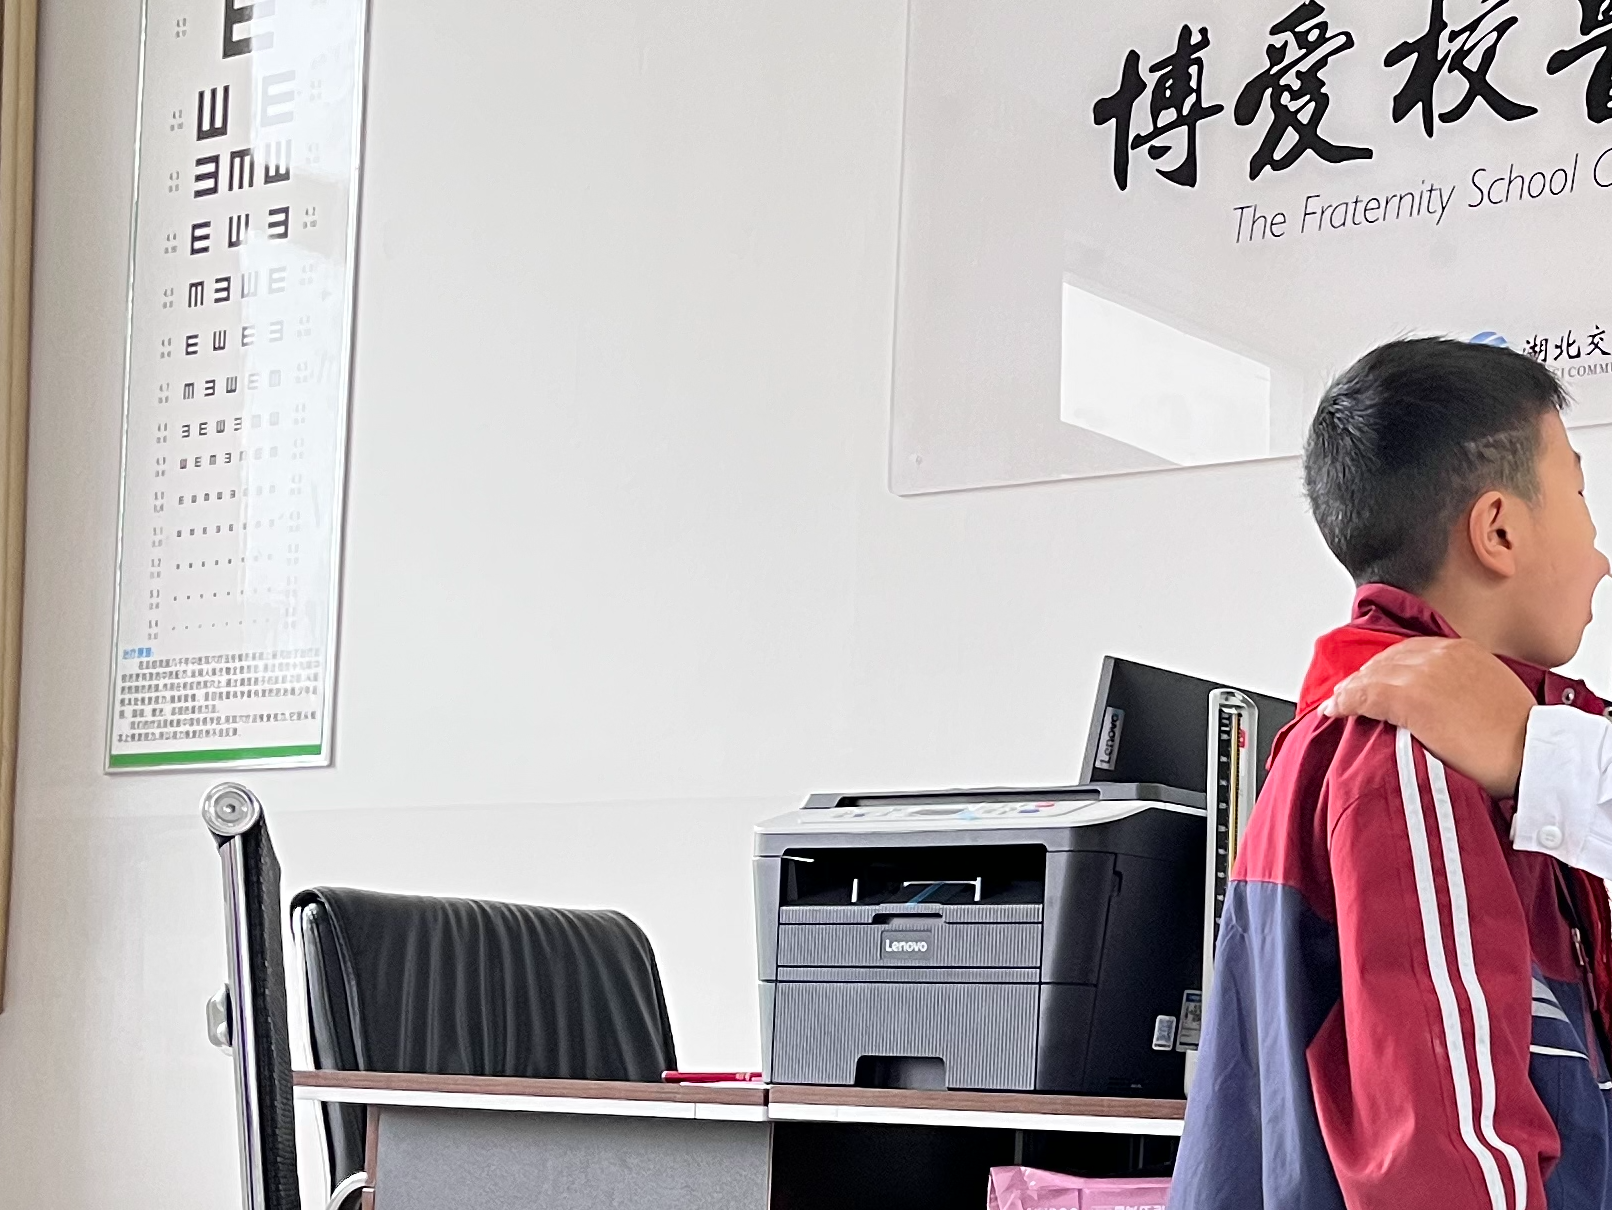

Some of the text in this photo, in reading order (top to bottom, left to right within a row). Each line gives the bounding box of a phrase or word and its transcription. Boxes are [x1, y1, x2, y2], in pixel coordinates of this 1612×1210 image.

[1233, 204, 1287, 244] The
[1300, 179, 1456, 235] Fraternity
[1468, 152, 1579, 208] School
[1100, 713, 1119, 764] Lenovo
[885, 938, 928, 952] Lenovo
